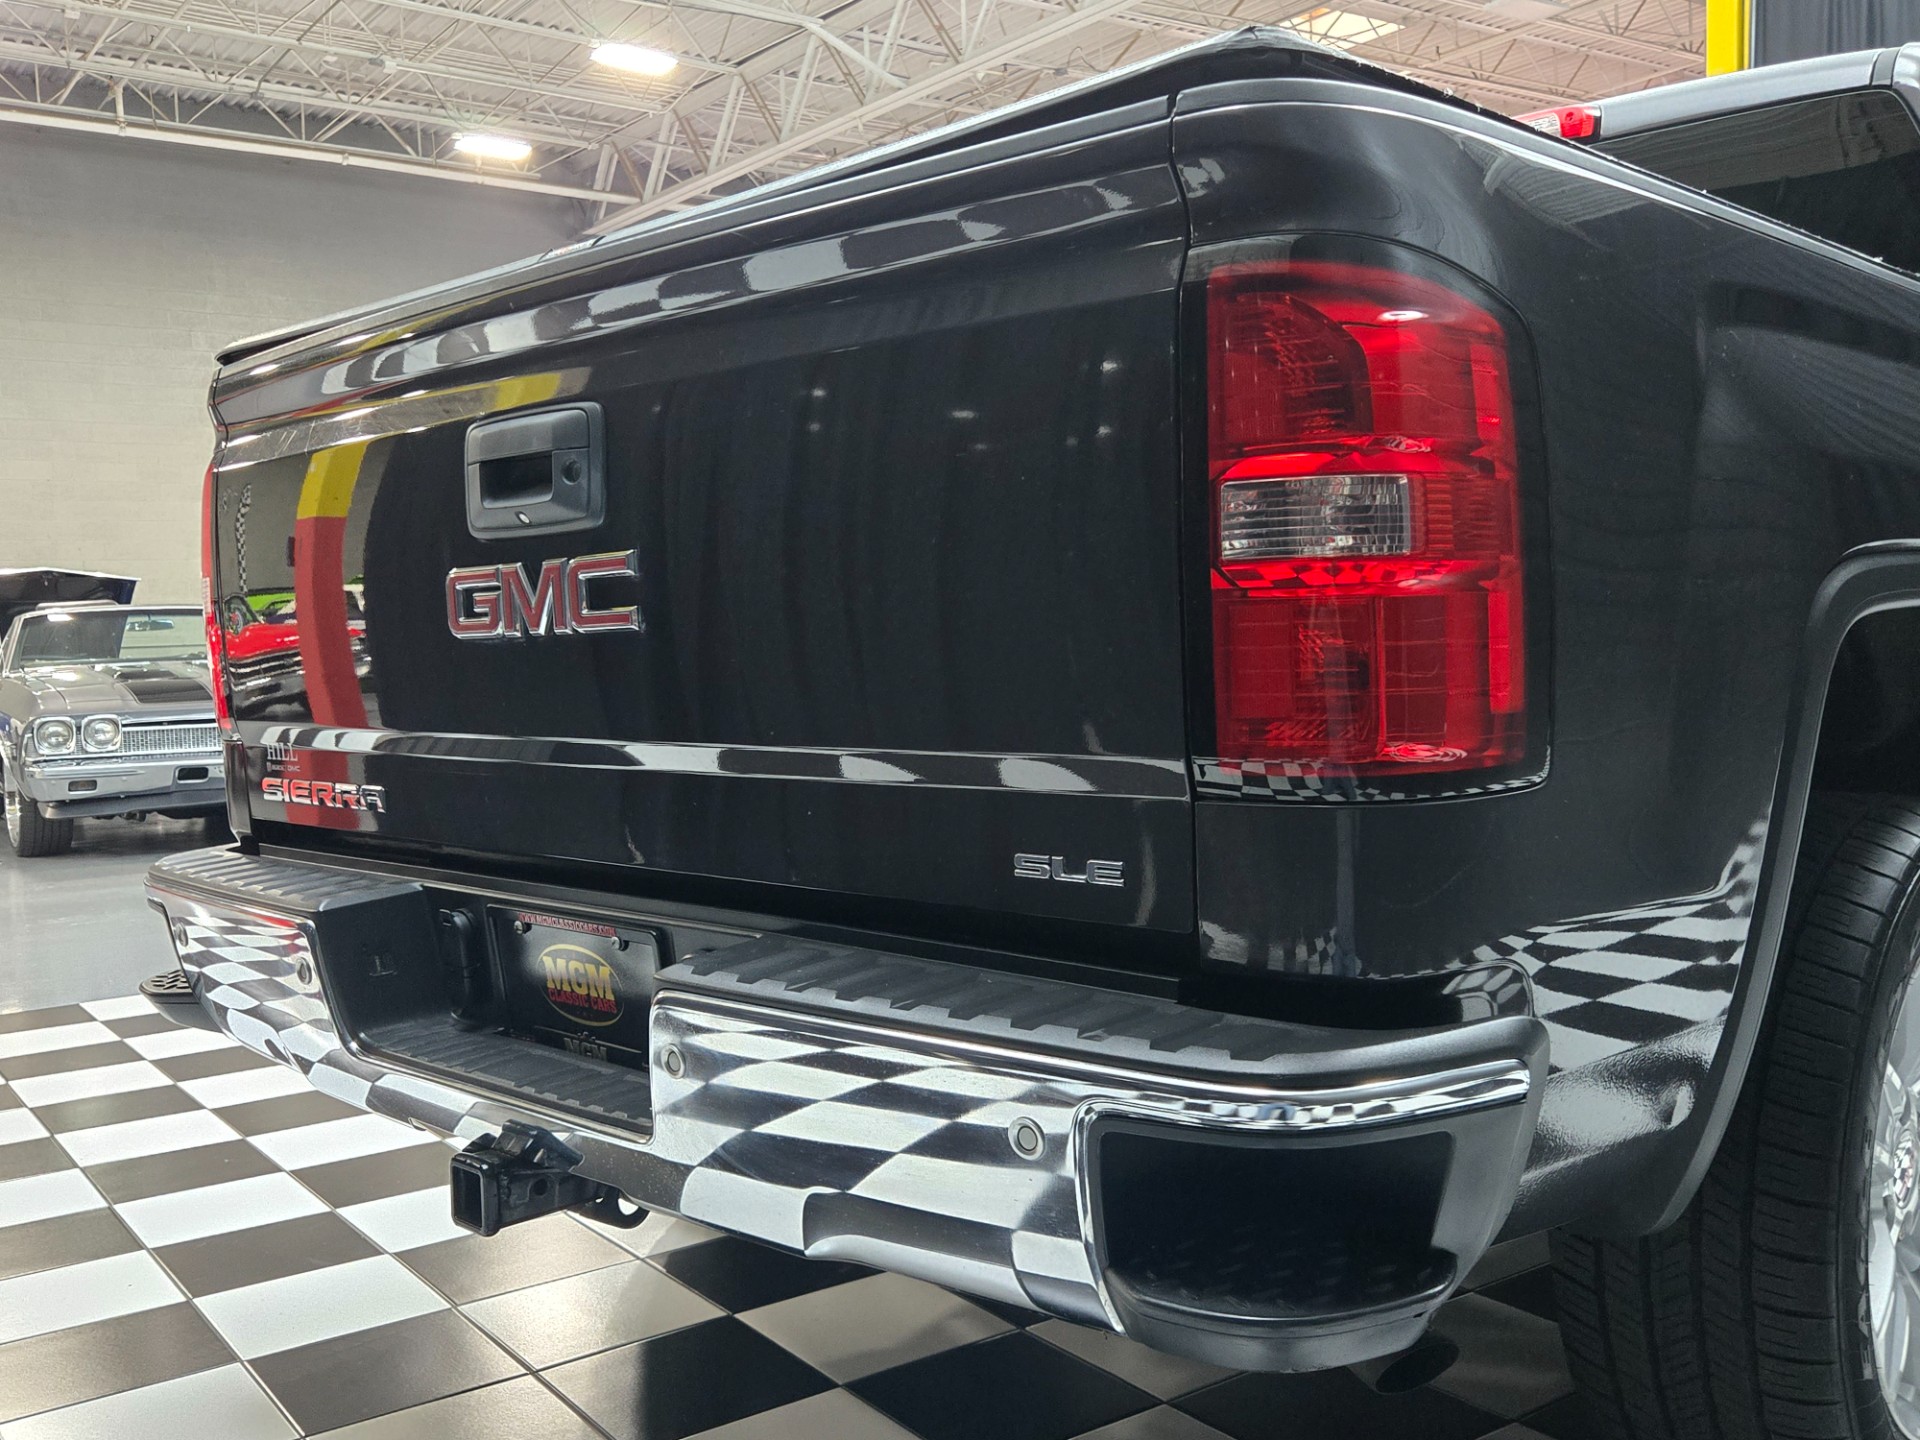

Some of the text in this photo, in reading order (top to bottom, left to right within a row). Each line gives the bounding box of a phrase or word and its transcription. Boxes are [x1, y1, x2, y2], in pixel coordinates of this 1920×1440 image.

[445, 548, 640, 639] GMC
[266, 742, 299, 761] HILL
[261, 777, 386, 814] SIERRA
[1013, 853, 1124, 887] SLE
[542, 956, 615, 1001] MGM
[546, 988, 617, 1014] CLASSIC CARS
